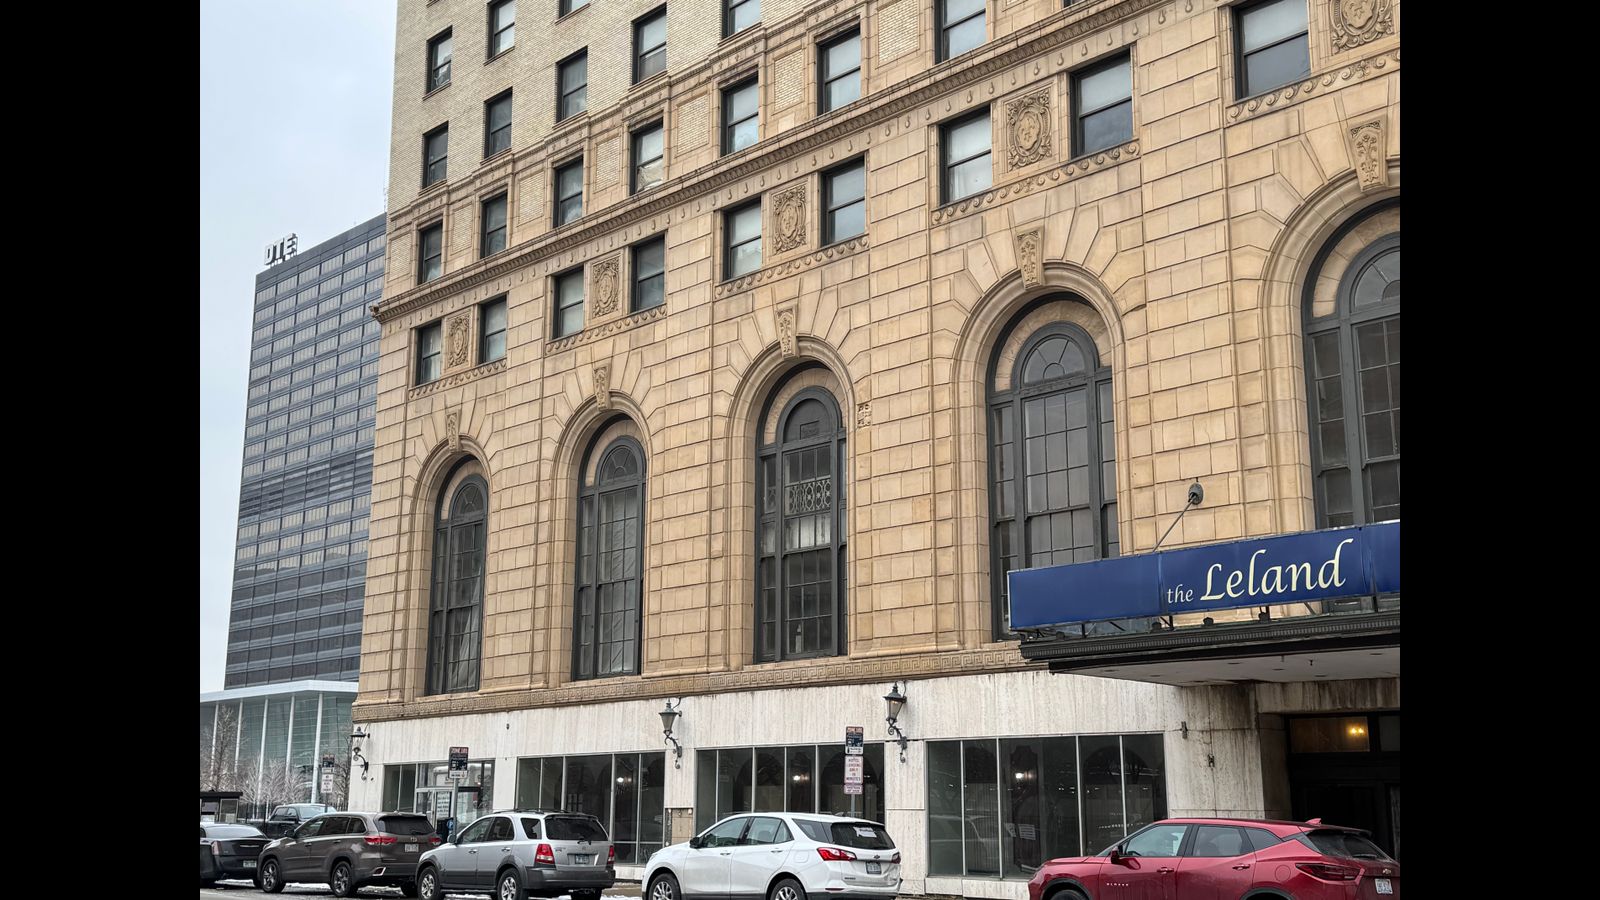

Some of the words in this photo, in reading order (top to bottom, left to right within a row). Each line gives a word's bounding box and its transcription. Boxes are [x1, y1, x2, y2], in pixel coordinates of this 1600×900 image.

[265, 233, 297, 265] DTE
[1167, 583, 1194, 604] the
[1200, 538, 1355, 601] Leland
